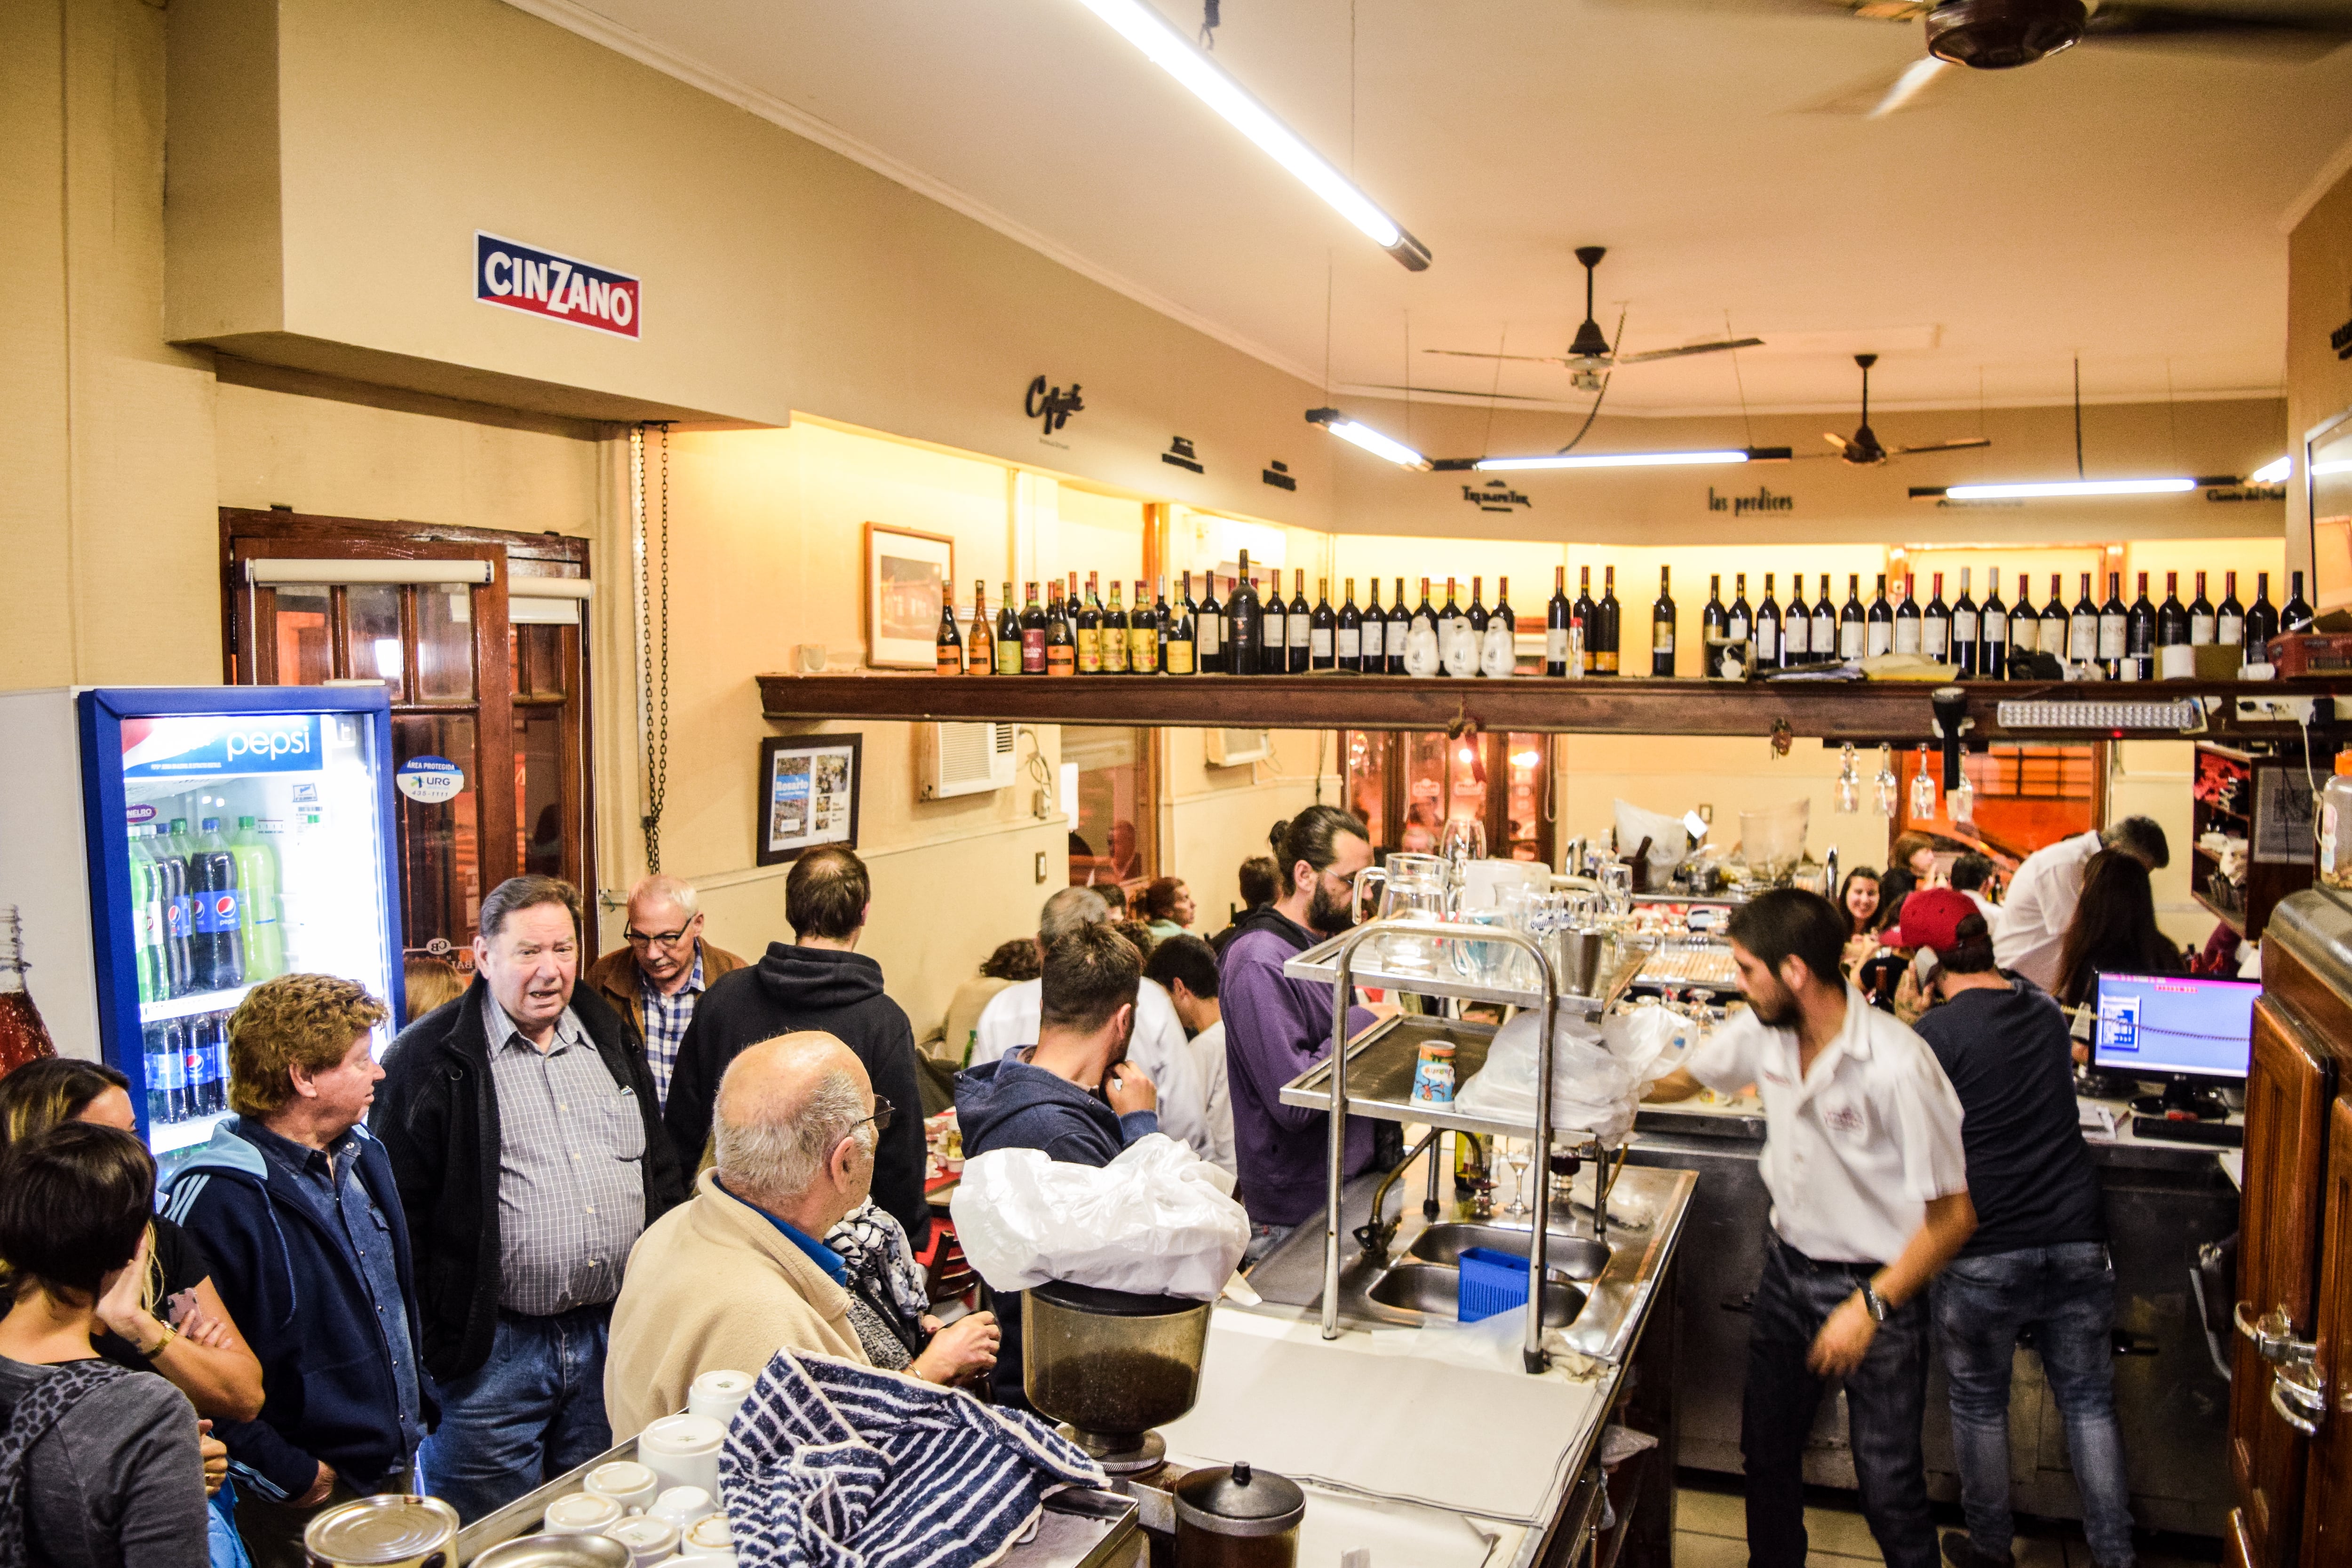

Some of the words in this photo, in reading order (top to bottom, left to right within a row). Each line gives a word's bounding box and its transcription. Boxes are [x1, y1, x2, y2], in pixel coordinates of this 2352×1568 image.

[485, 251, 633, 326] CINZANO
[227, 725, 310, 761] pepsi
[407, 760, 422, 769] ÁREA
[427, 777, 450, 786] URG
[126, 808, 152, 818] NELRO
